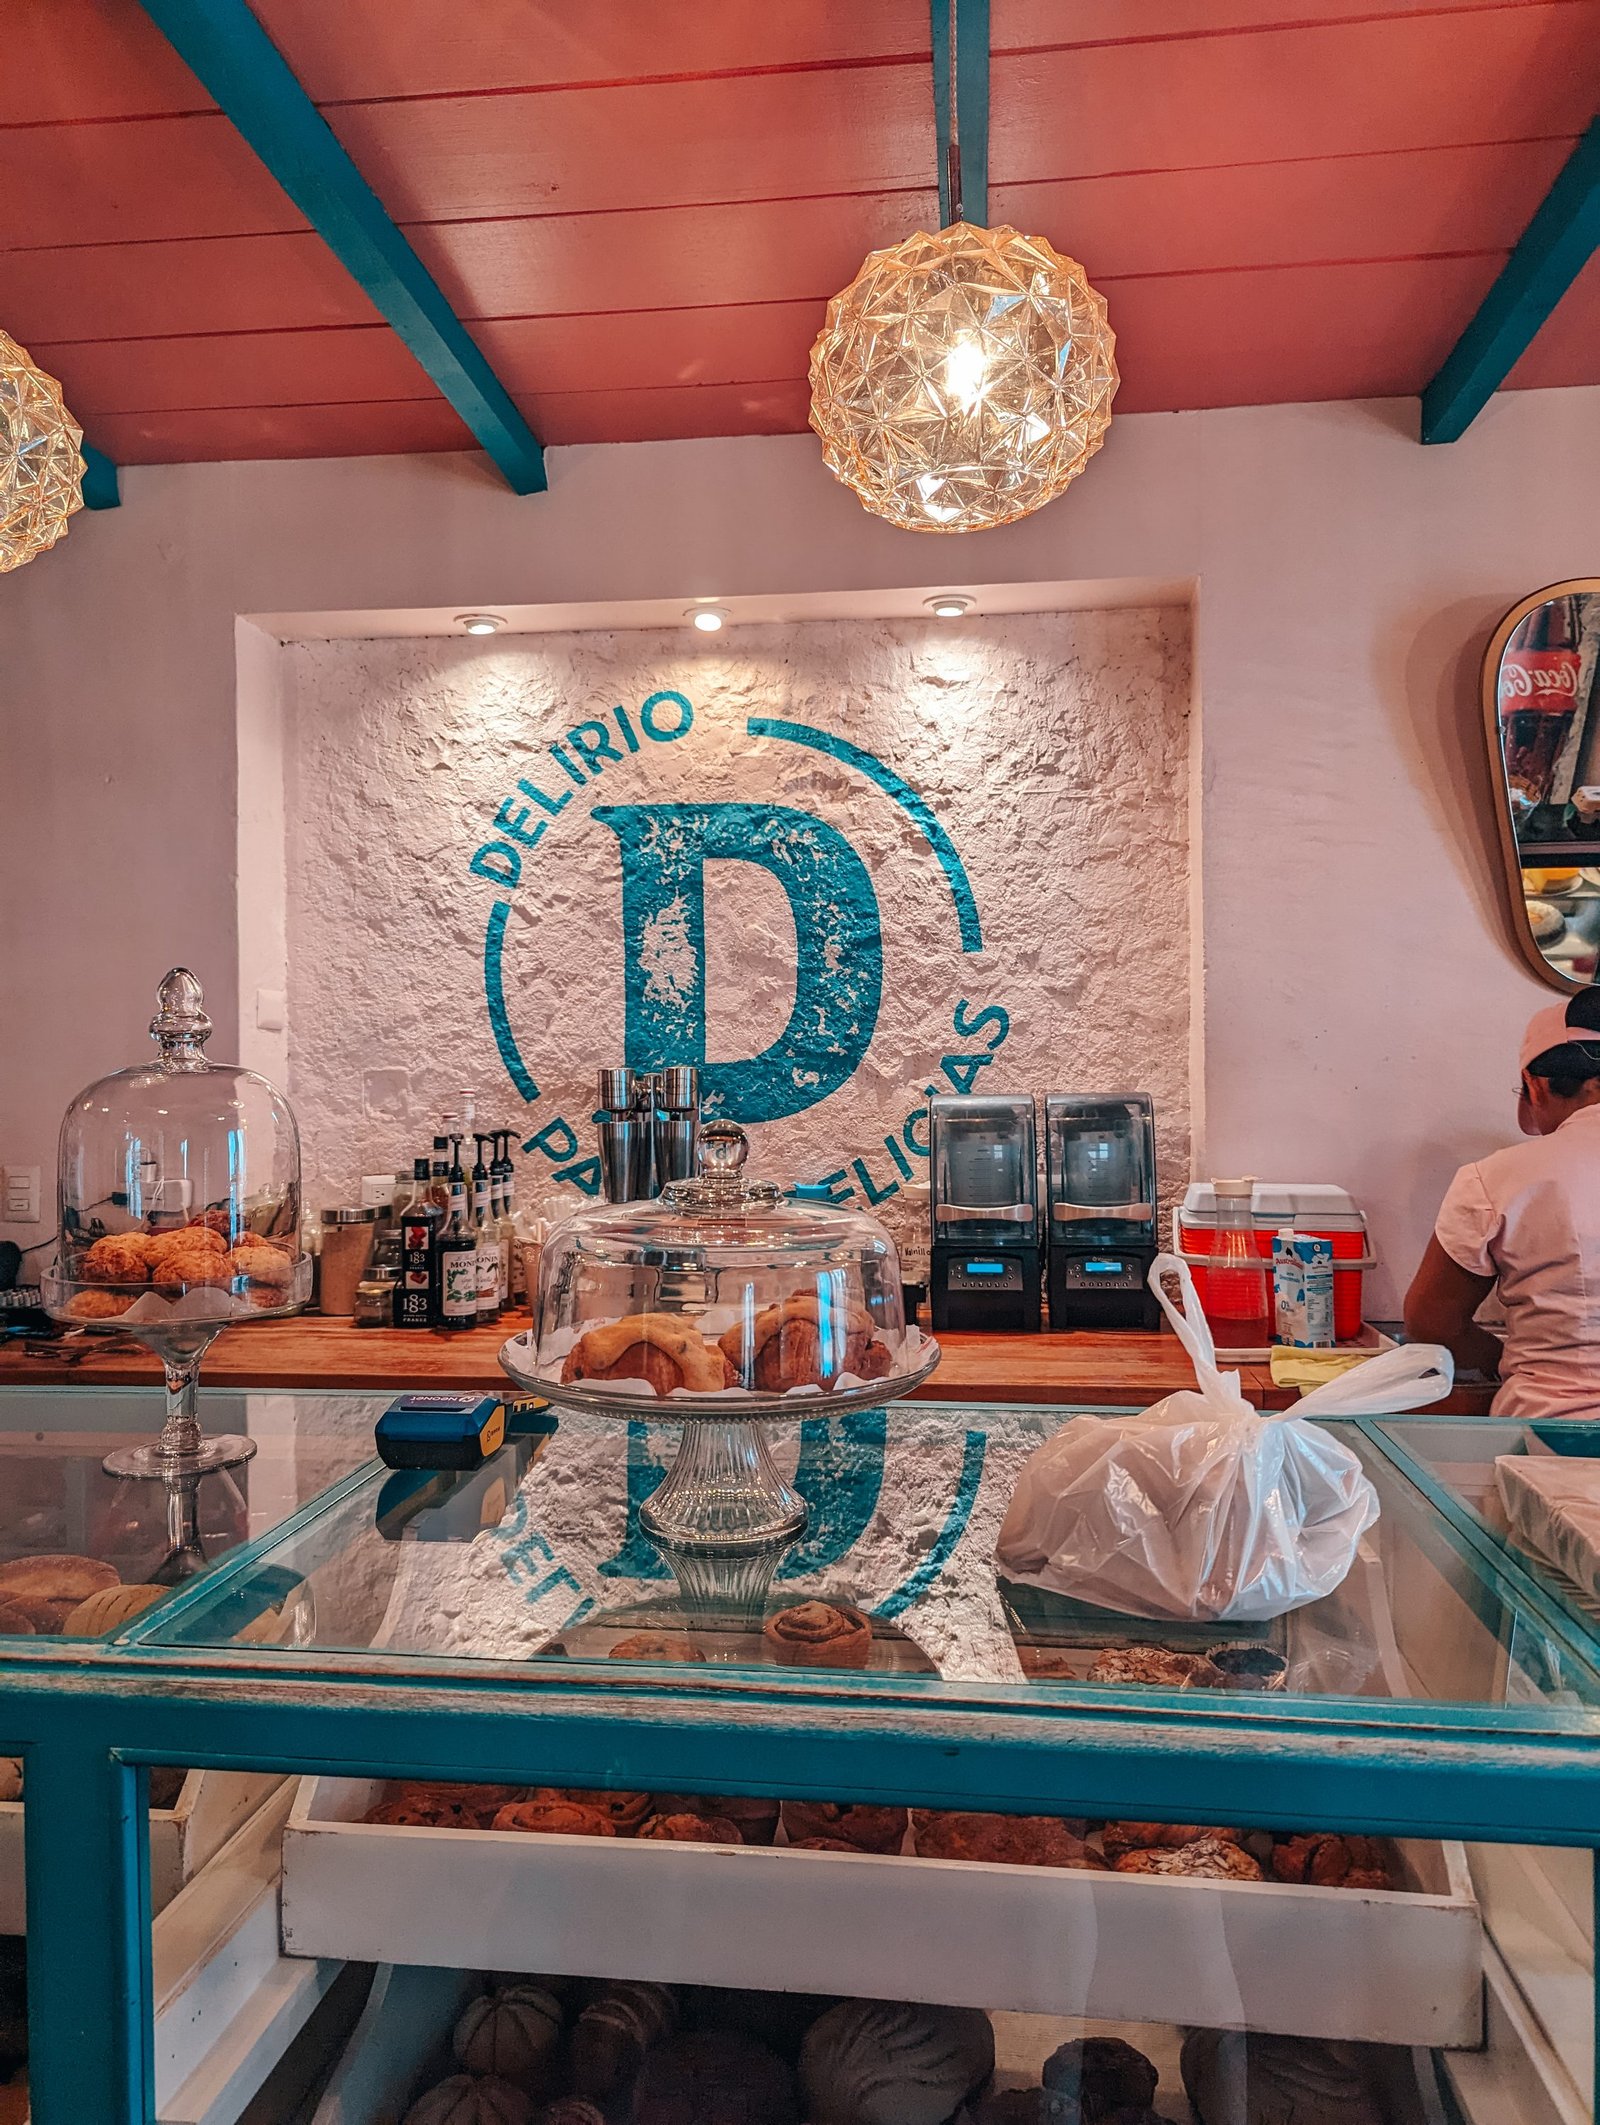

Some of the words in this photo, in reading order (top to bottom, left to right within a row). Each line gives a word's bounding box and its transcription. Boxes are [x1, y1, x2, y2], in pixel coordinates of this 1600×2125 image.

[469, 690, 694, 890] DELIRIO
[591, 803, 884, 1125] D
[783, 998, 1011, 1211] ELICAS
[402, 1293, 428, 1313] 1883
